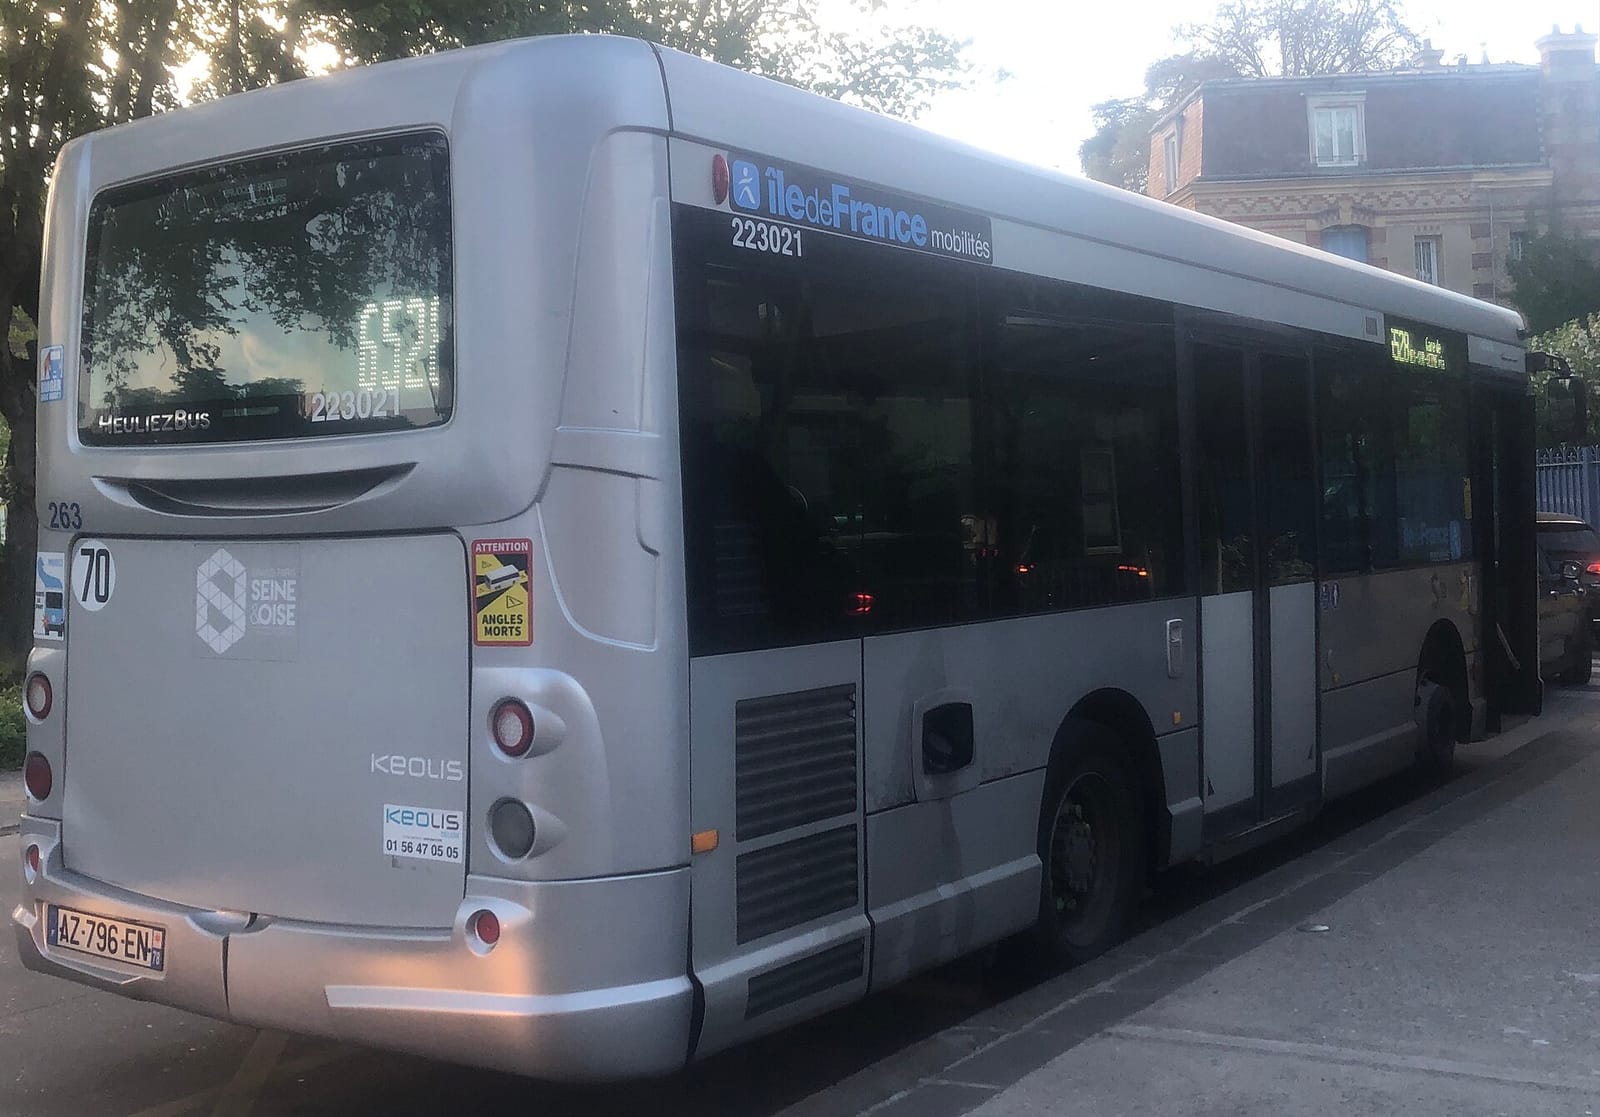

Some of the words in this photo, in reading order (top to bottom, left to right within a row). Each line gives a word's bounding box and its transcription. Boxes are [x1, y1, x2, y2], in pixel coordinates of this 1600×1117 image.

[731, 217, 803, 257] 223021
[931, 229, 991, 259] mobilités
[311, 388, 401, 424] 223021
[48, 502, 82, 529] 263
[475, 542, 528, 553] ATTENTION
[80, 548, 110, 603] 70
[251, 579, 296, 601] SEINE
[482, 614, 523, 625] ANGLES
[484, 626, 522, 637] MORTS
[386, 839, 398, 851] 01
[401, 841, 414, 853] 56
[416, 843, 429, 855] 47
[431, 844, 443, 857] 05
[446, 846, 459, 859] 05
